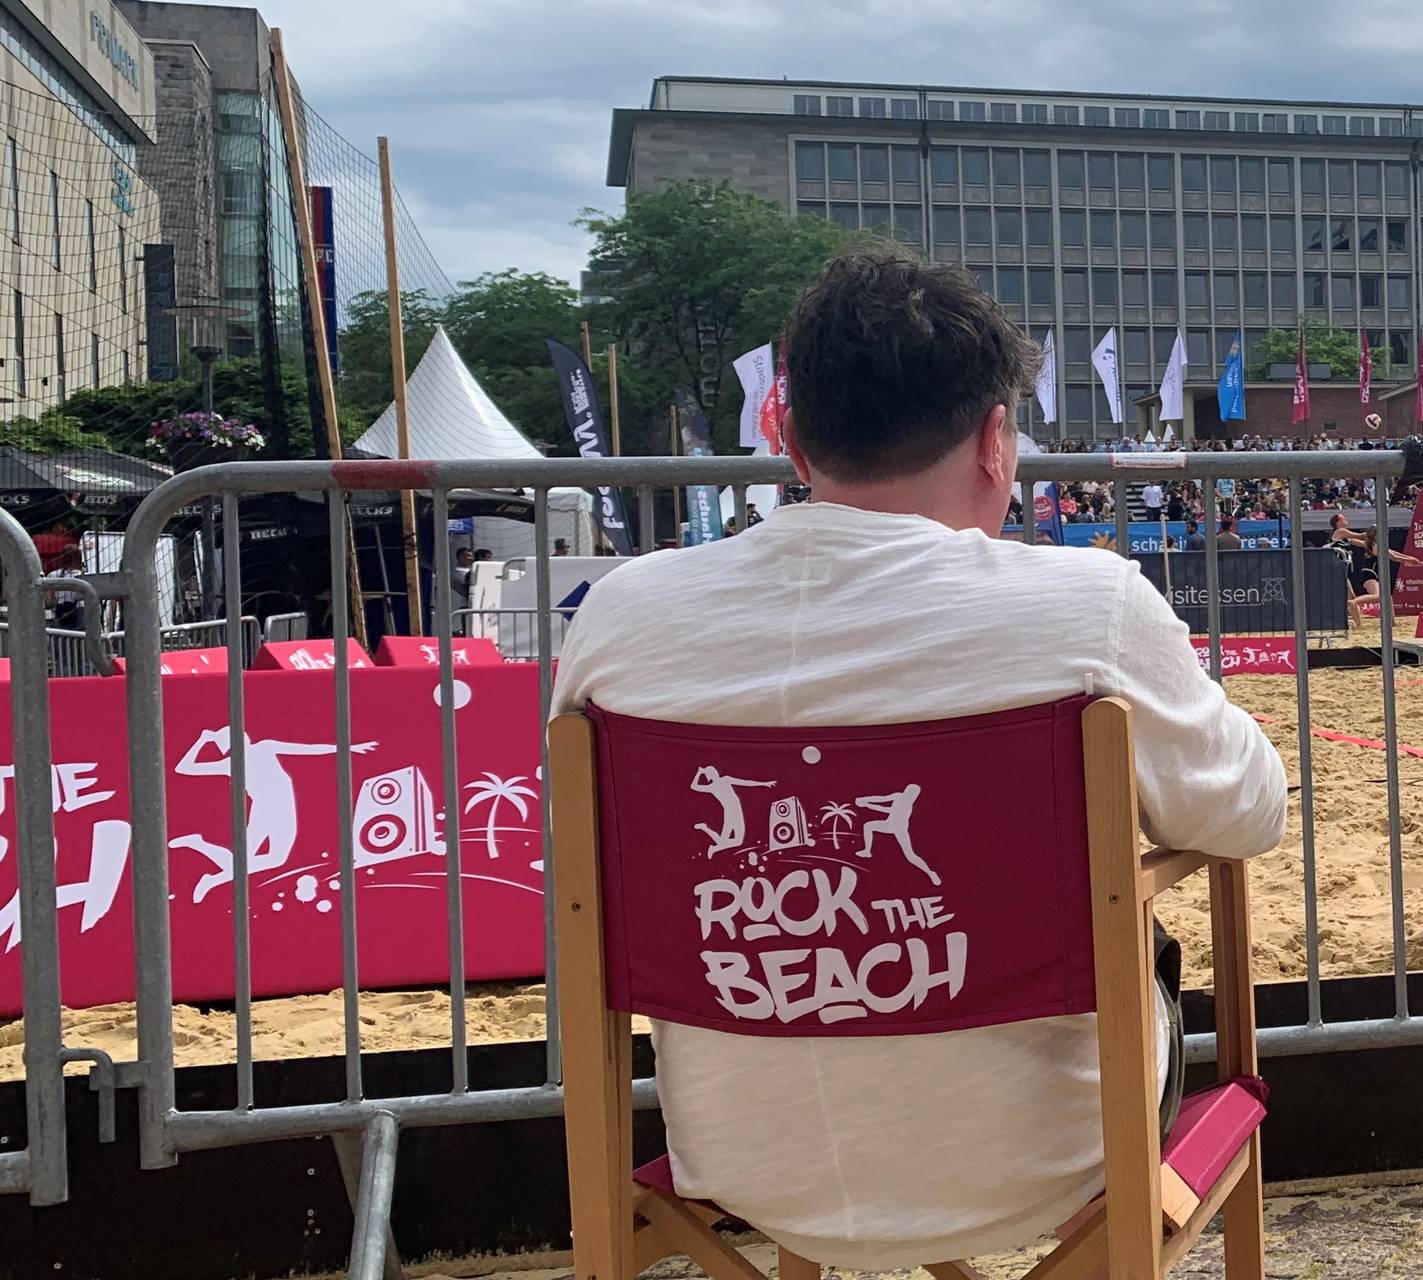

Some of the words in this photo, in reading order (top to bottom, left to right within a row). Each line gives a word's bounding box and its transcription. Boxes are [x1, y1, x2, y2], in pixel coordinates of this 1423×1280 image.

[693, 866, 870, 942] ROCK
[871, 895, 955, 934] THE
[699, 931, 968, 1025] BEACH
